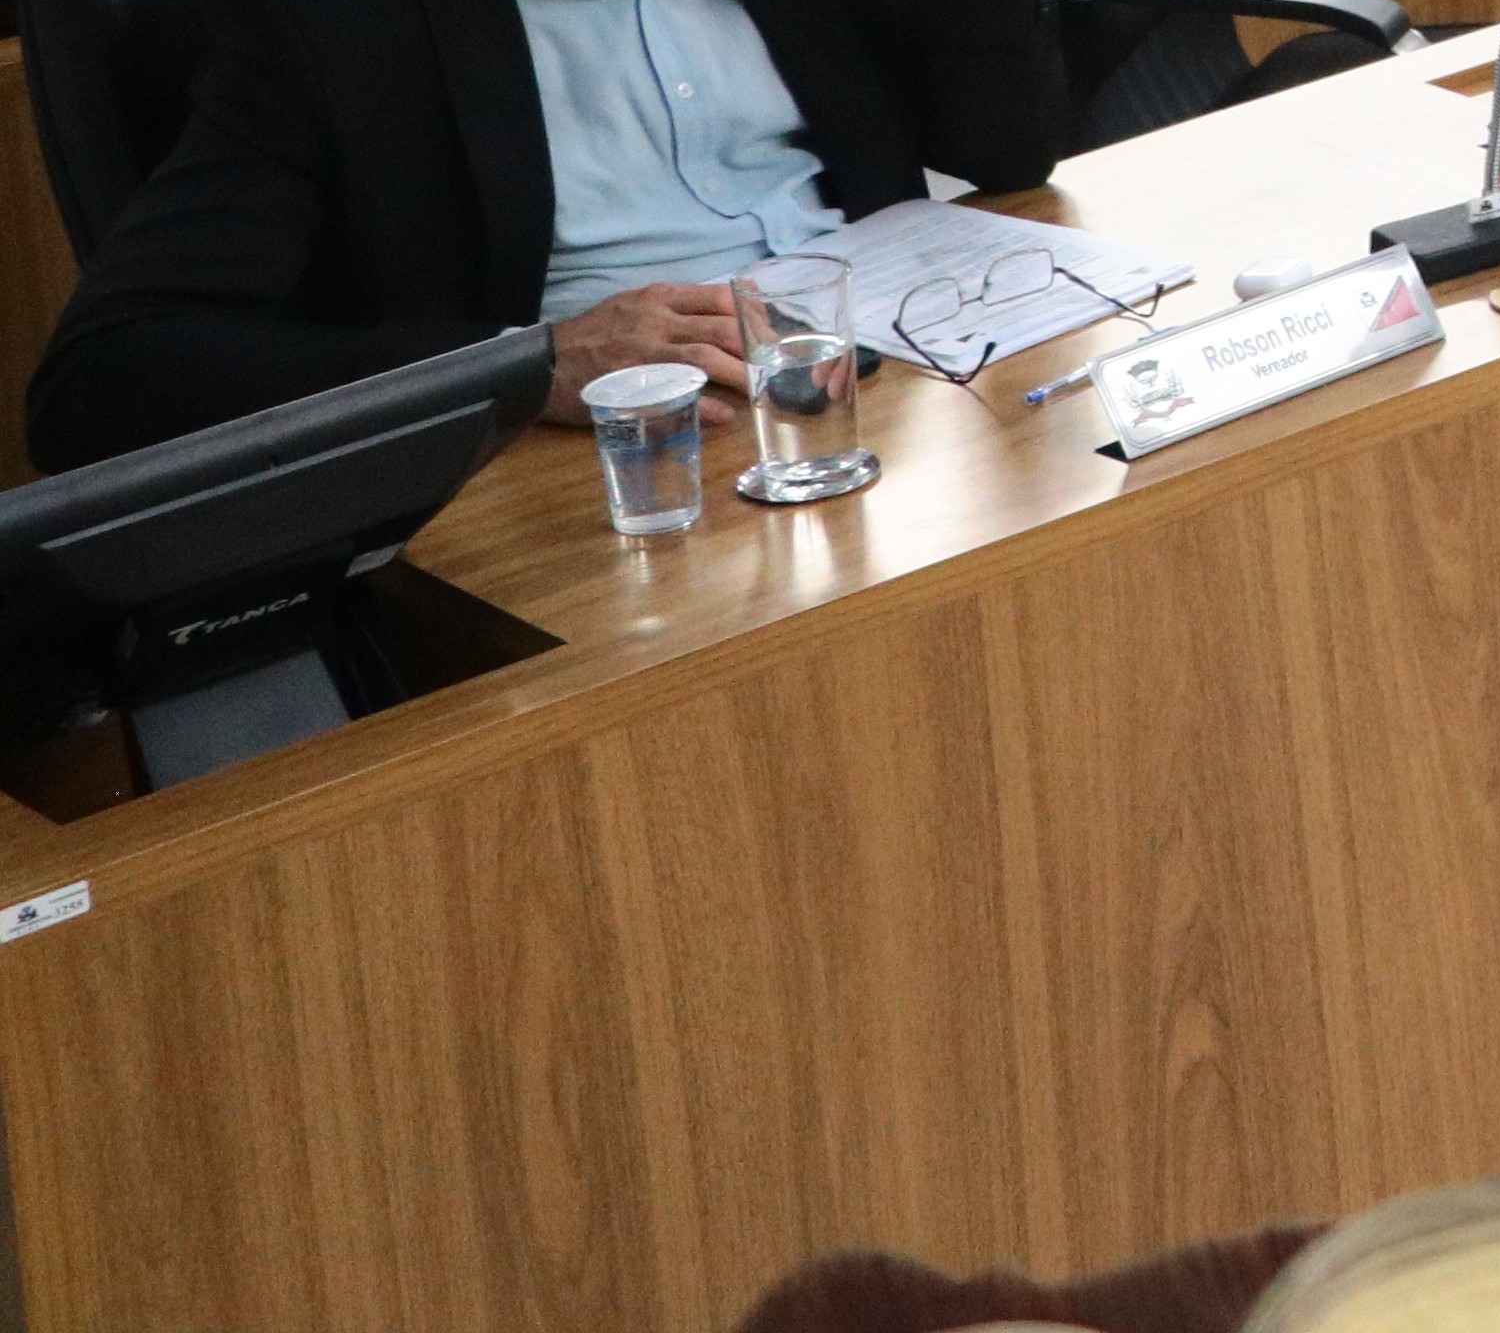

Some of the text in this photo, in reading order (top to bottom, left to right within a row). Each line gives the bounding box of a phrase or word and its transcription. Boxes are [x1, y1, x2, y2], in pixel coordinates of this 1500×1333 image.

[1202, 303, 1335, 374] Robson Ricci
[1250, 346, 1310, 380] Vereador
[203, 591, 310, 634] TANCA
